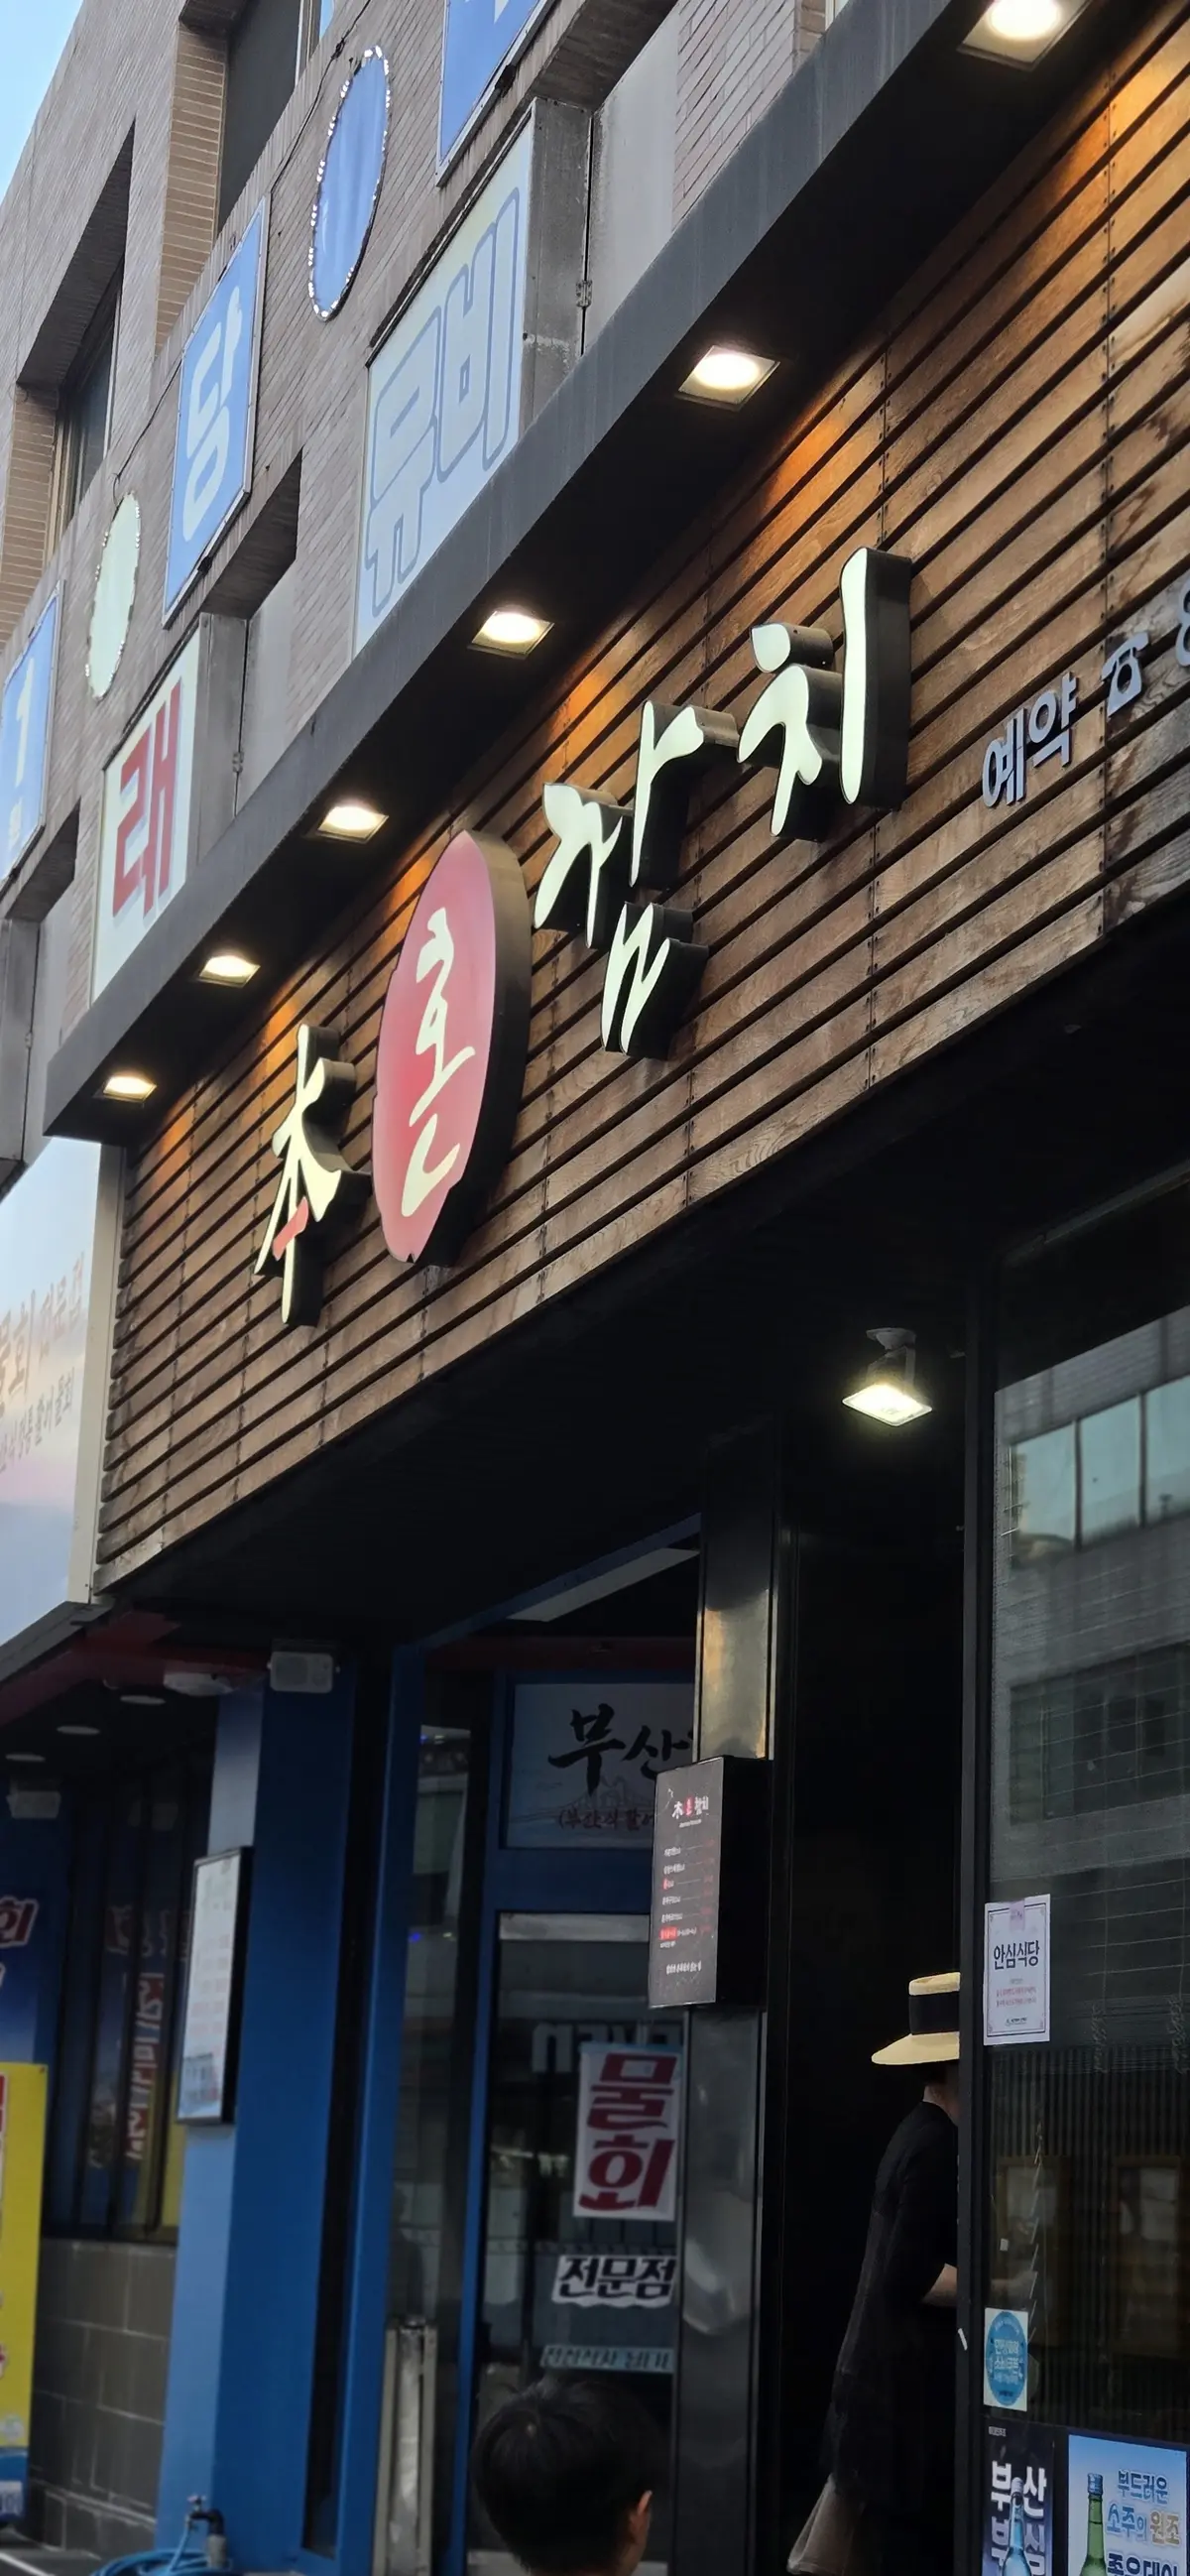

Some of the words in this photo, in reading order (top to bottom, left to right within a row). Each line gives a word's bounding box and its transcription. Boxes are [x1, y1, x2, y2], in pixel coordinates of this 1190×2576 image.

[184, 288, 241, 543] 당
[364, 187, 520, 617] 유비
[983, 672, 1077, 806] 예약
[112, 680, 180, 918] 래
[993, 1940, 1039, 1970] 안심식당
[579, 2052, 677, 2211] 물회
[559, 2256, 675, 2299] 전문점
[991, 2460, 1047, 2518] 부산
[1107, 2503, 1147, 2542] 소주의
[1149, 2510, 1180, 2546] 원조
[1118, 2469, 1168, 2505] 부드러운
